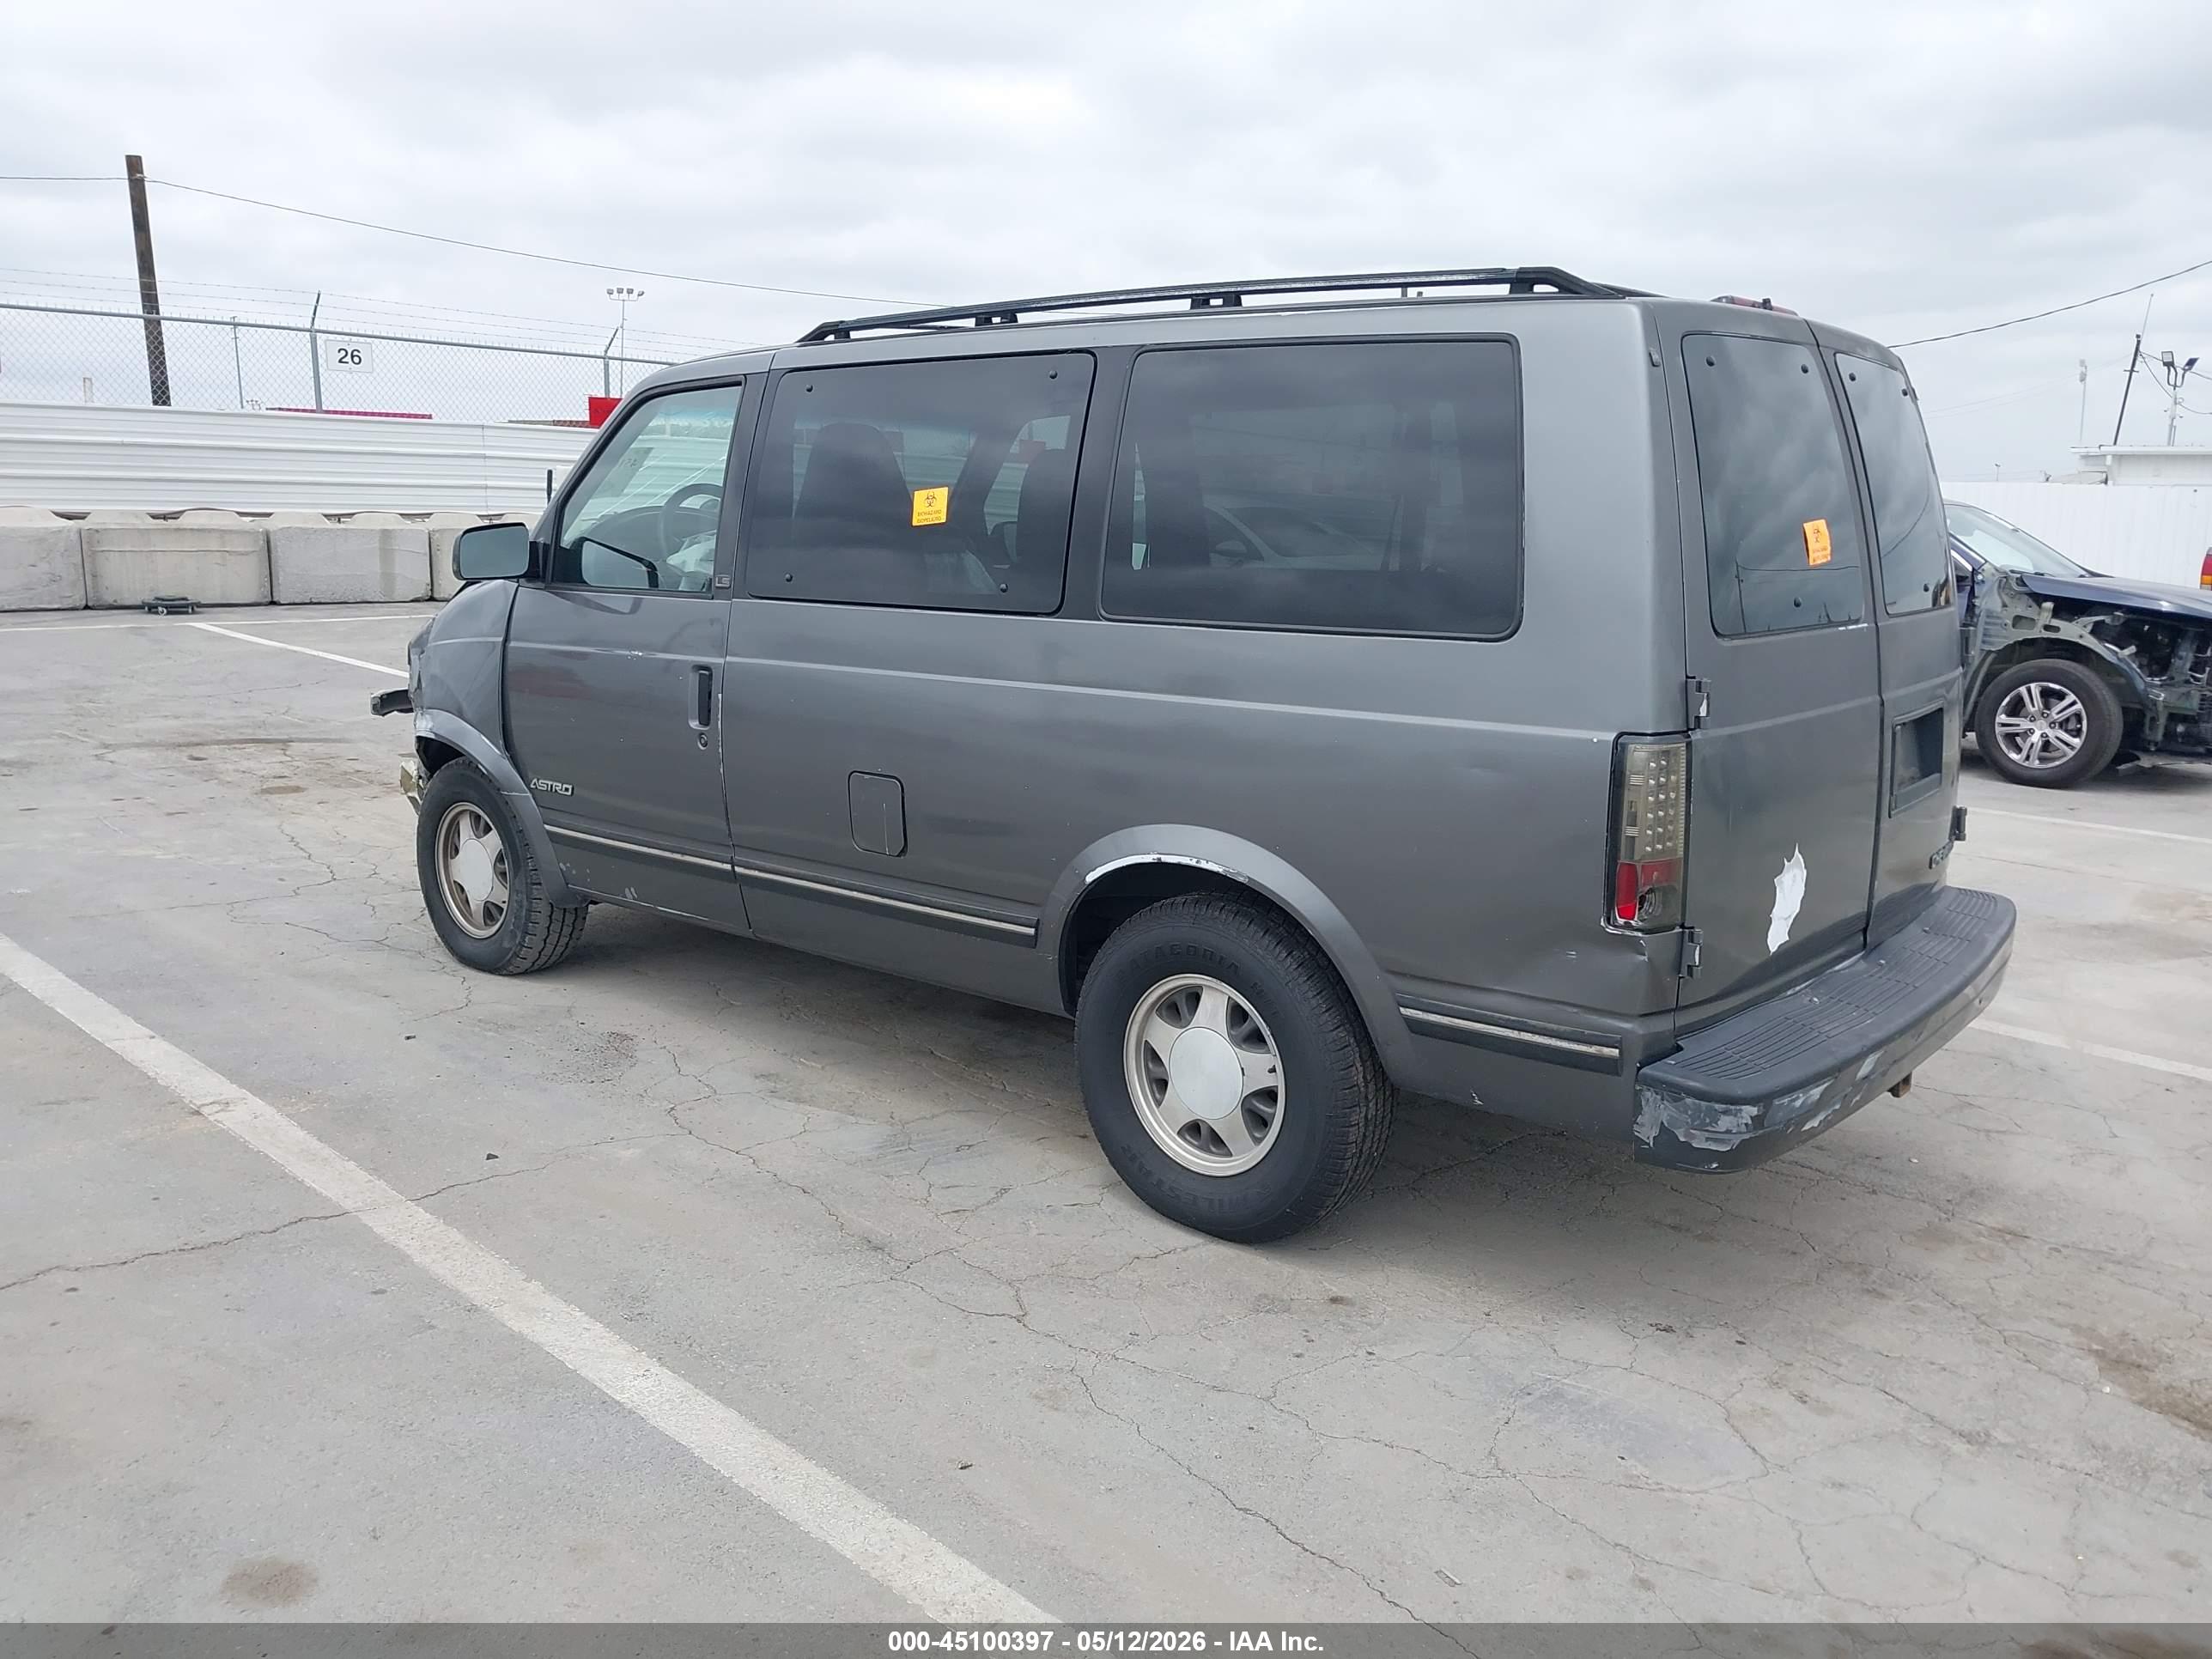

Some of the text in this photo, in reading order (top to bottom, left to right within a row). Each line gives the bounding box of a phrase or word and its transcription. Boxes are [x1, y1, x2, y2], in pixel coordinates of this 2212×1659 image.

[337, 348, 362, 365] 26
[715, 577, 730, 586] LS
[530, 777, 572, 795] ASTRO
